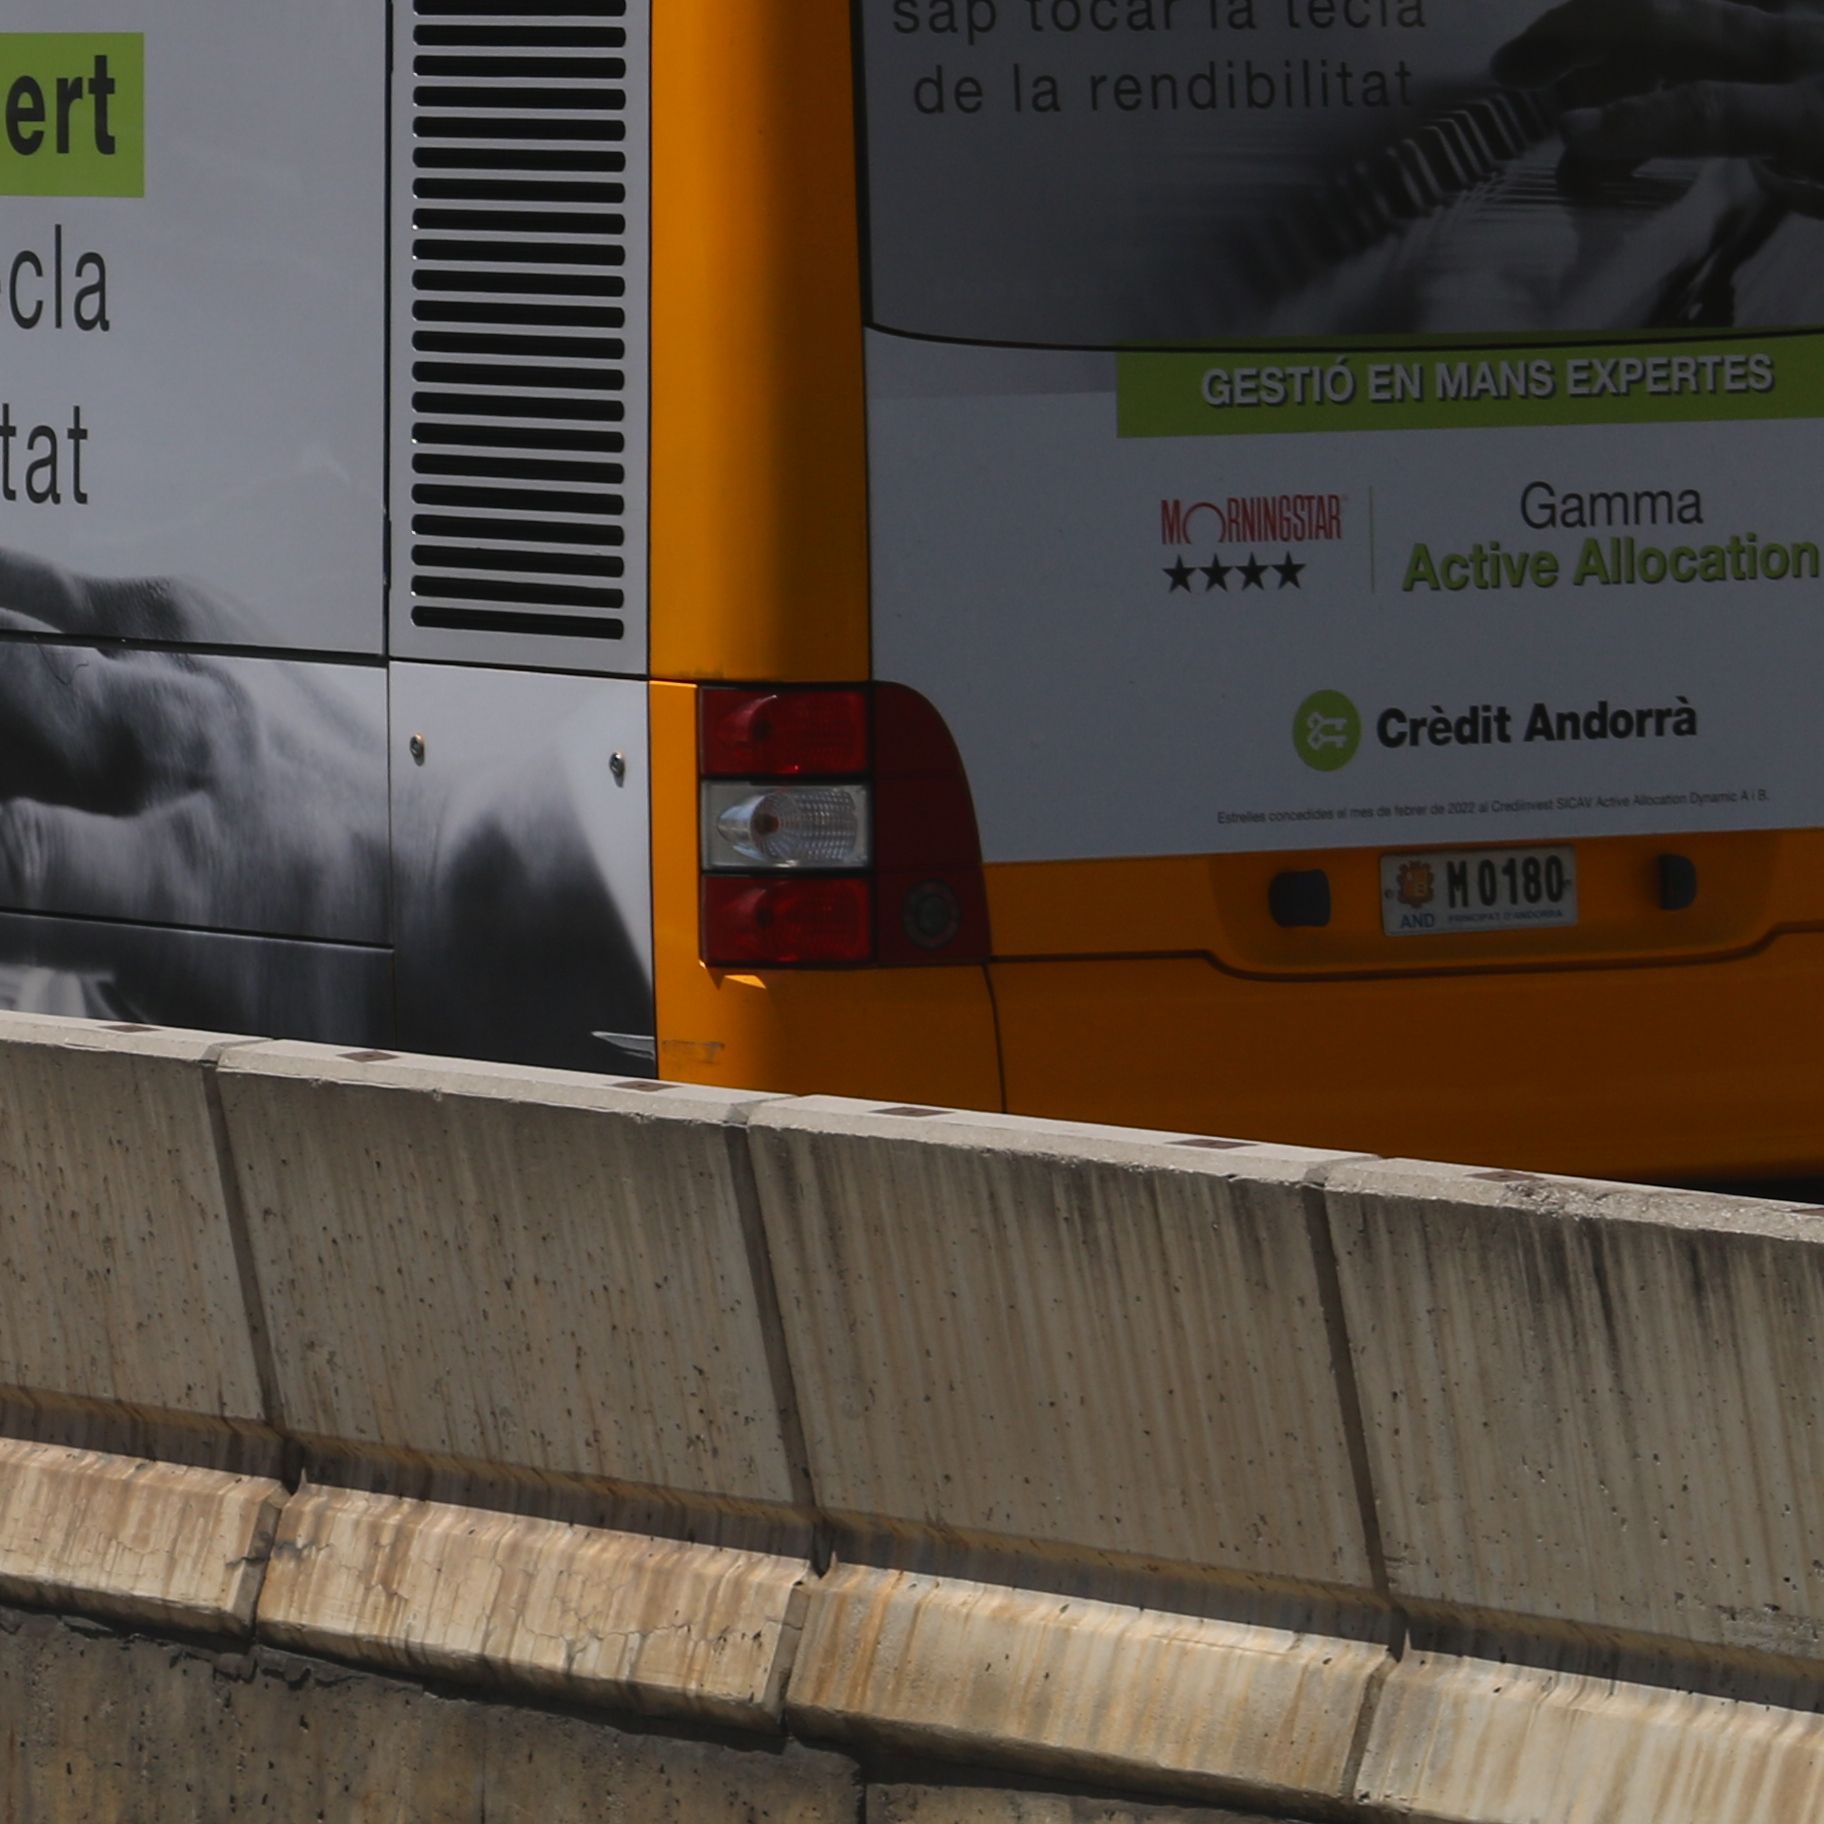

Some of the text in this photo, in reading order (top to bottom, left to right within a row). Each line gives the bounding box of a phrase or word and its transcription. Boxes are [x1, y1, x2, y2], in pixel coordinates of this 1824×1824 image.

[912, 59, 1414, 115] de la rendibilitat
[1202, 353, 1775, 408] GESTIÓ EN MANS EXPERTES
[1161, 493, 1342, 546] MORNINGSTAR
[1520, 480, 1703, 530] Gamma
[1401, 531, 1820, 592] Active Allocation
[1376, 696, 1698, 748] Crèdit Andorrà
[1430, 803, 1444, 815] de
[1448, 801, 1475, 814] 2022
[1596, 794, 1630, 808] Active
[1633, 792, 1688, 807] Allocation
[1400, 913, 1436, 929] AND
